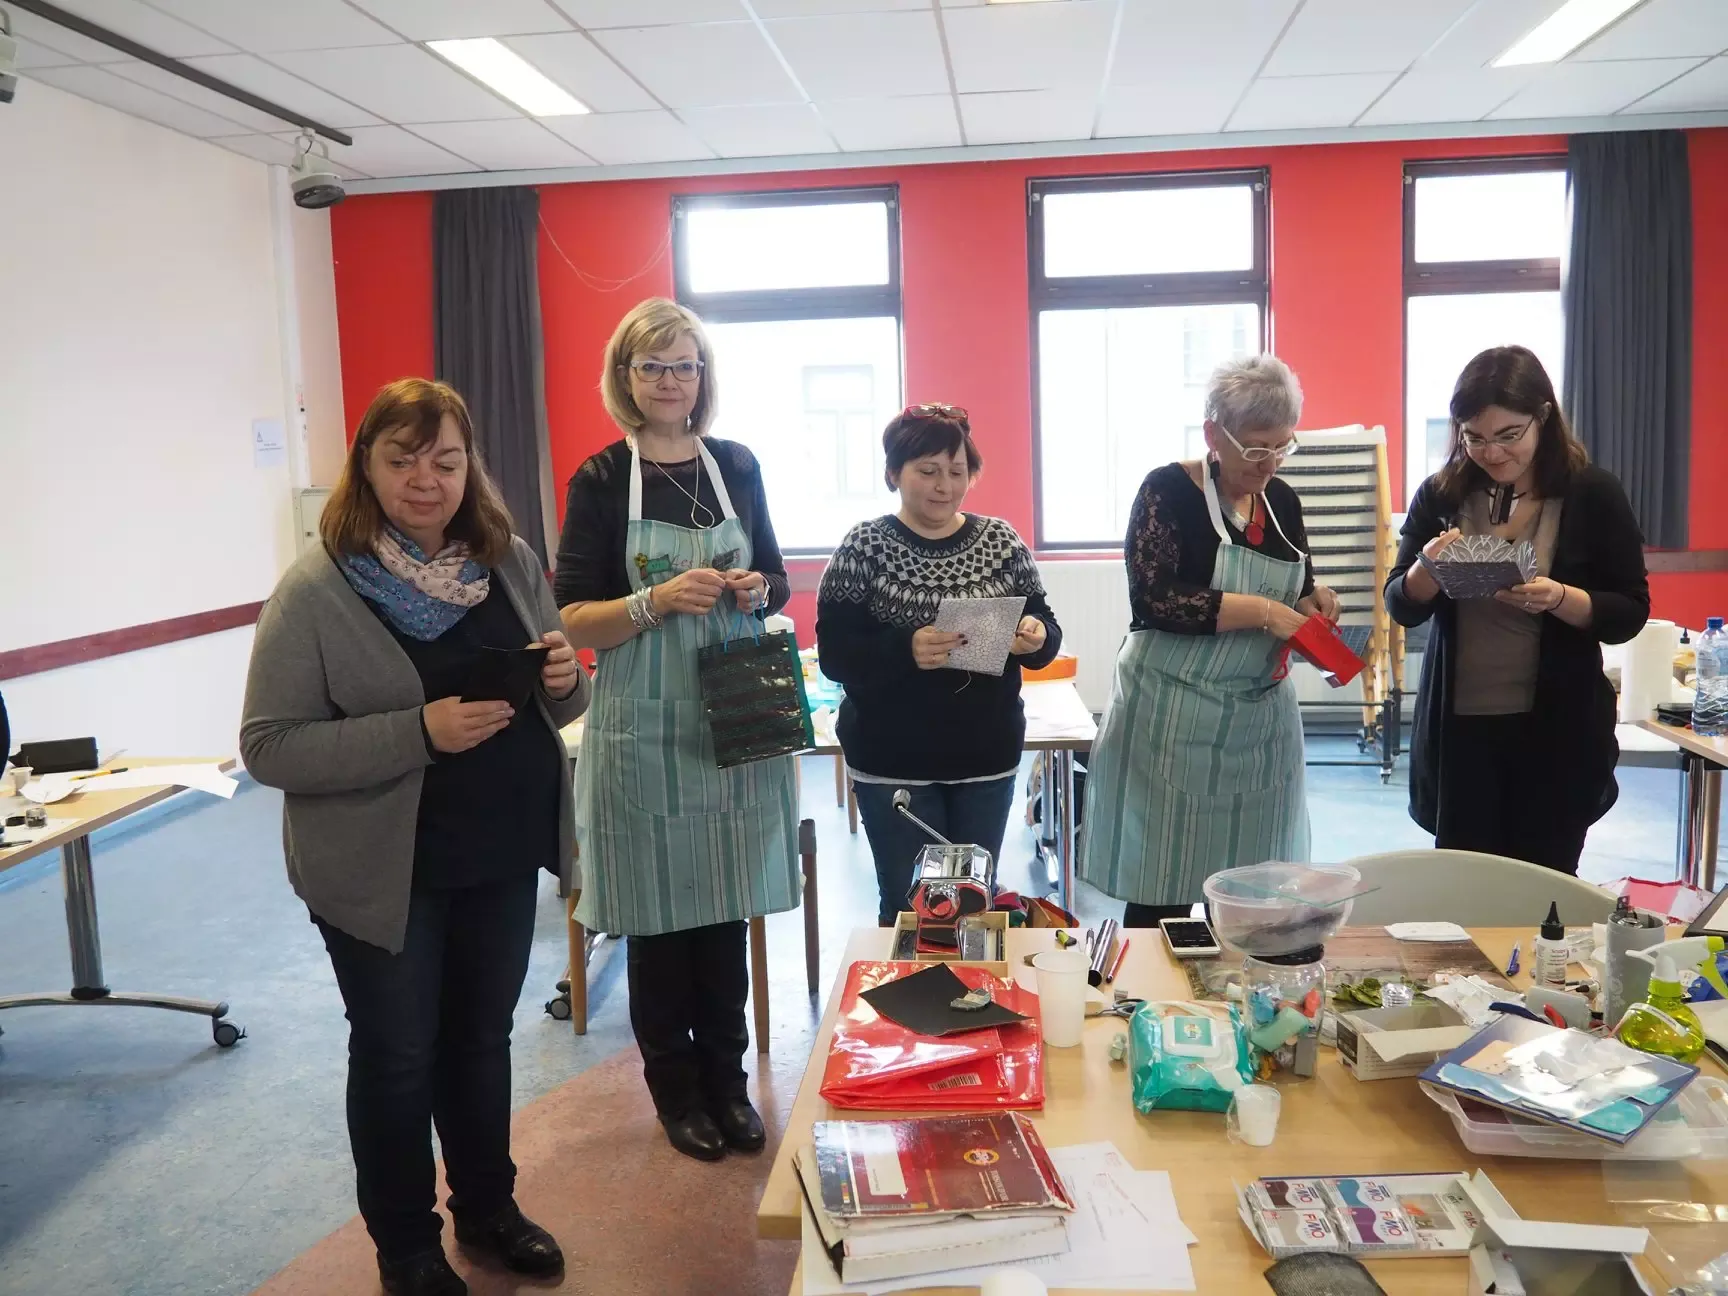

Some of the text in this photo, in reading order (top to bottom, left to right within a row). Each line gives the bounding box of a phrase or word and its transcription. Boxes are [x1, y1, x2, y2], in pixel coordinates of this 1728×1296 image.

[1292, 1183, 1312, 1203] FIMO
[1362, 1181, 1384, 1202] FIMO
[1303, 1213, 1325, 1238] FIMO
[1380, 1210, 1403, 1236] FIMO
